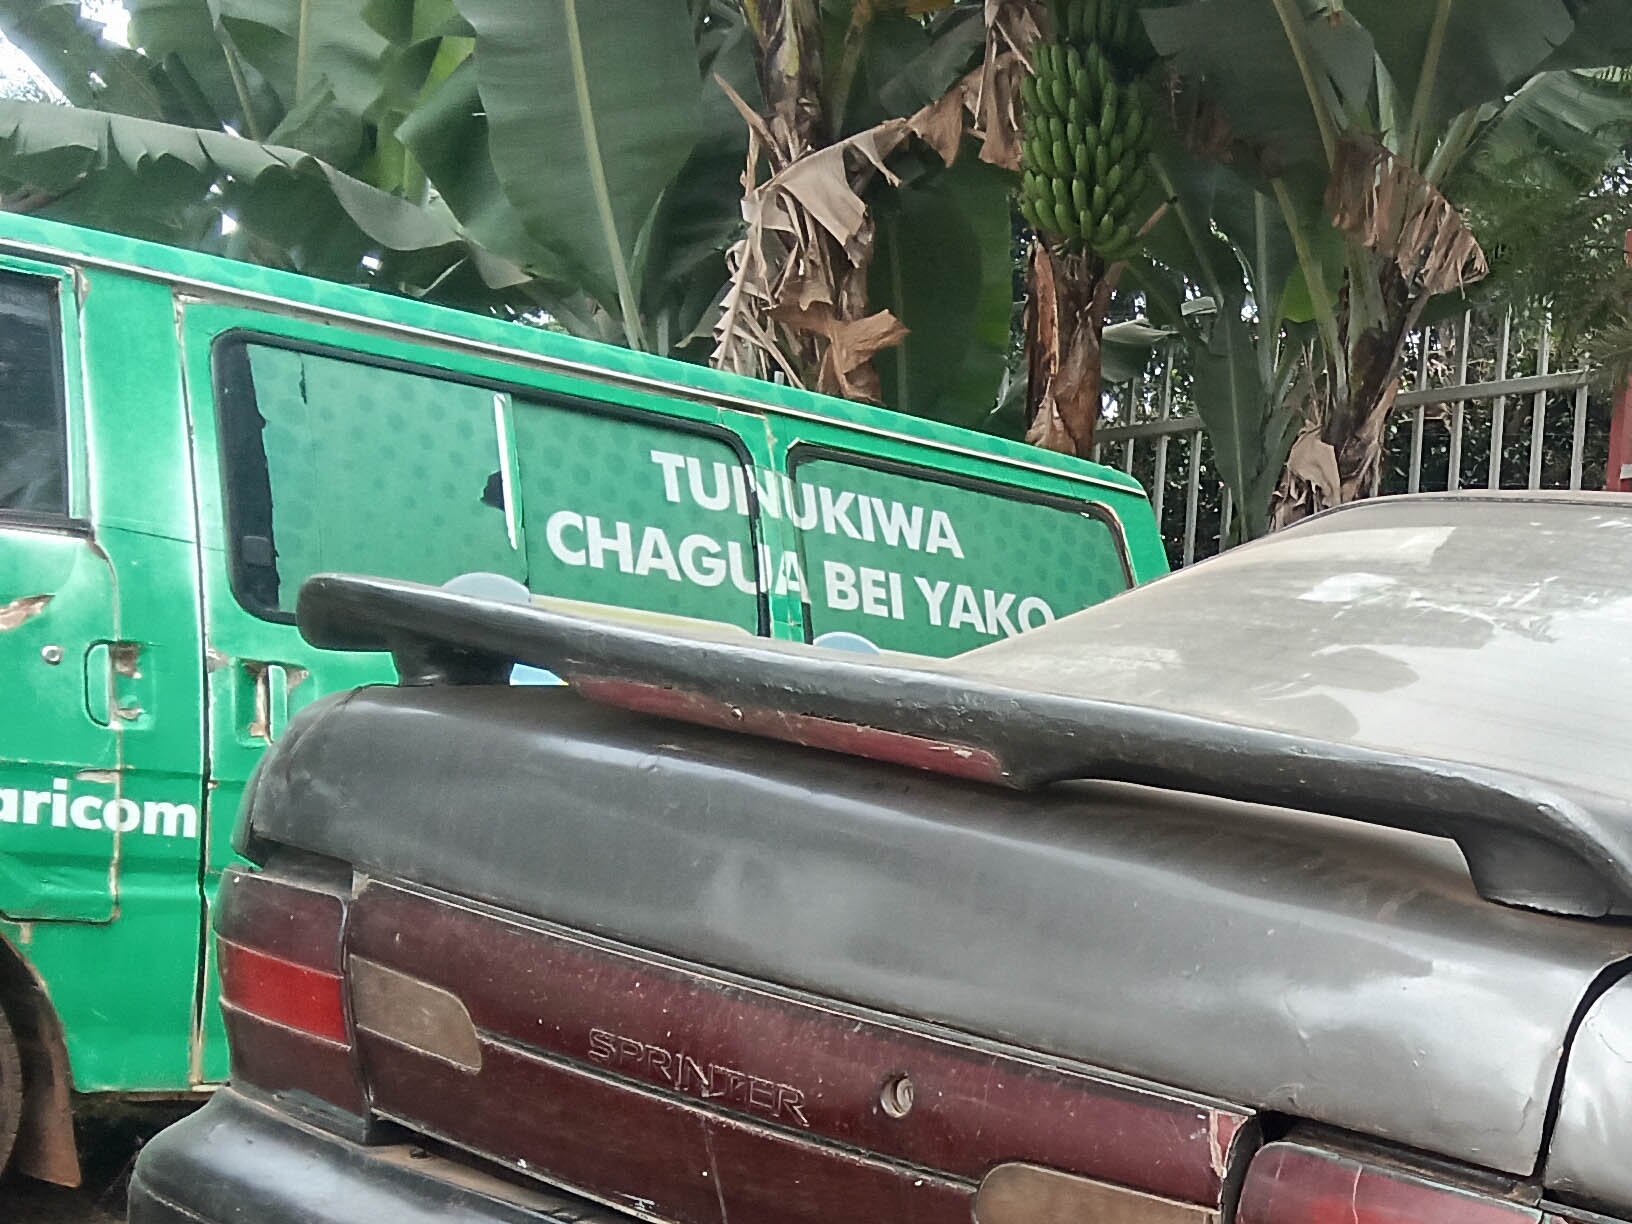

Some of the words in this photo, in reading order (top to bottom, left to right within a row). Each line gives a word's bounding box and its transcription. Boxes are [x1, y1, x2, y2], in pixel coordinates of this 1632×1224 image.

[650, 450, 964, 560] TUNUKIWA
[546, 510, 811, 604] CHAGUA
[823, 561, 905, 620] BEI
[914, 576, 1055, 639] YAKO
[588, 1028, 810, 1128] SPRINTER
